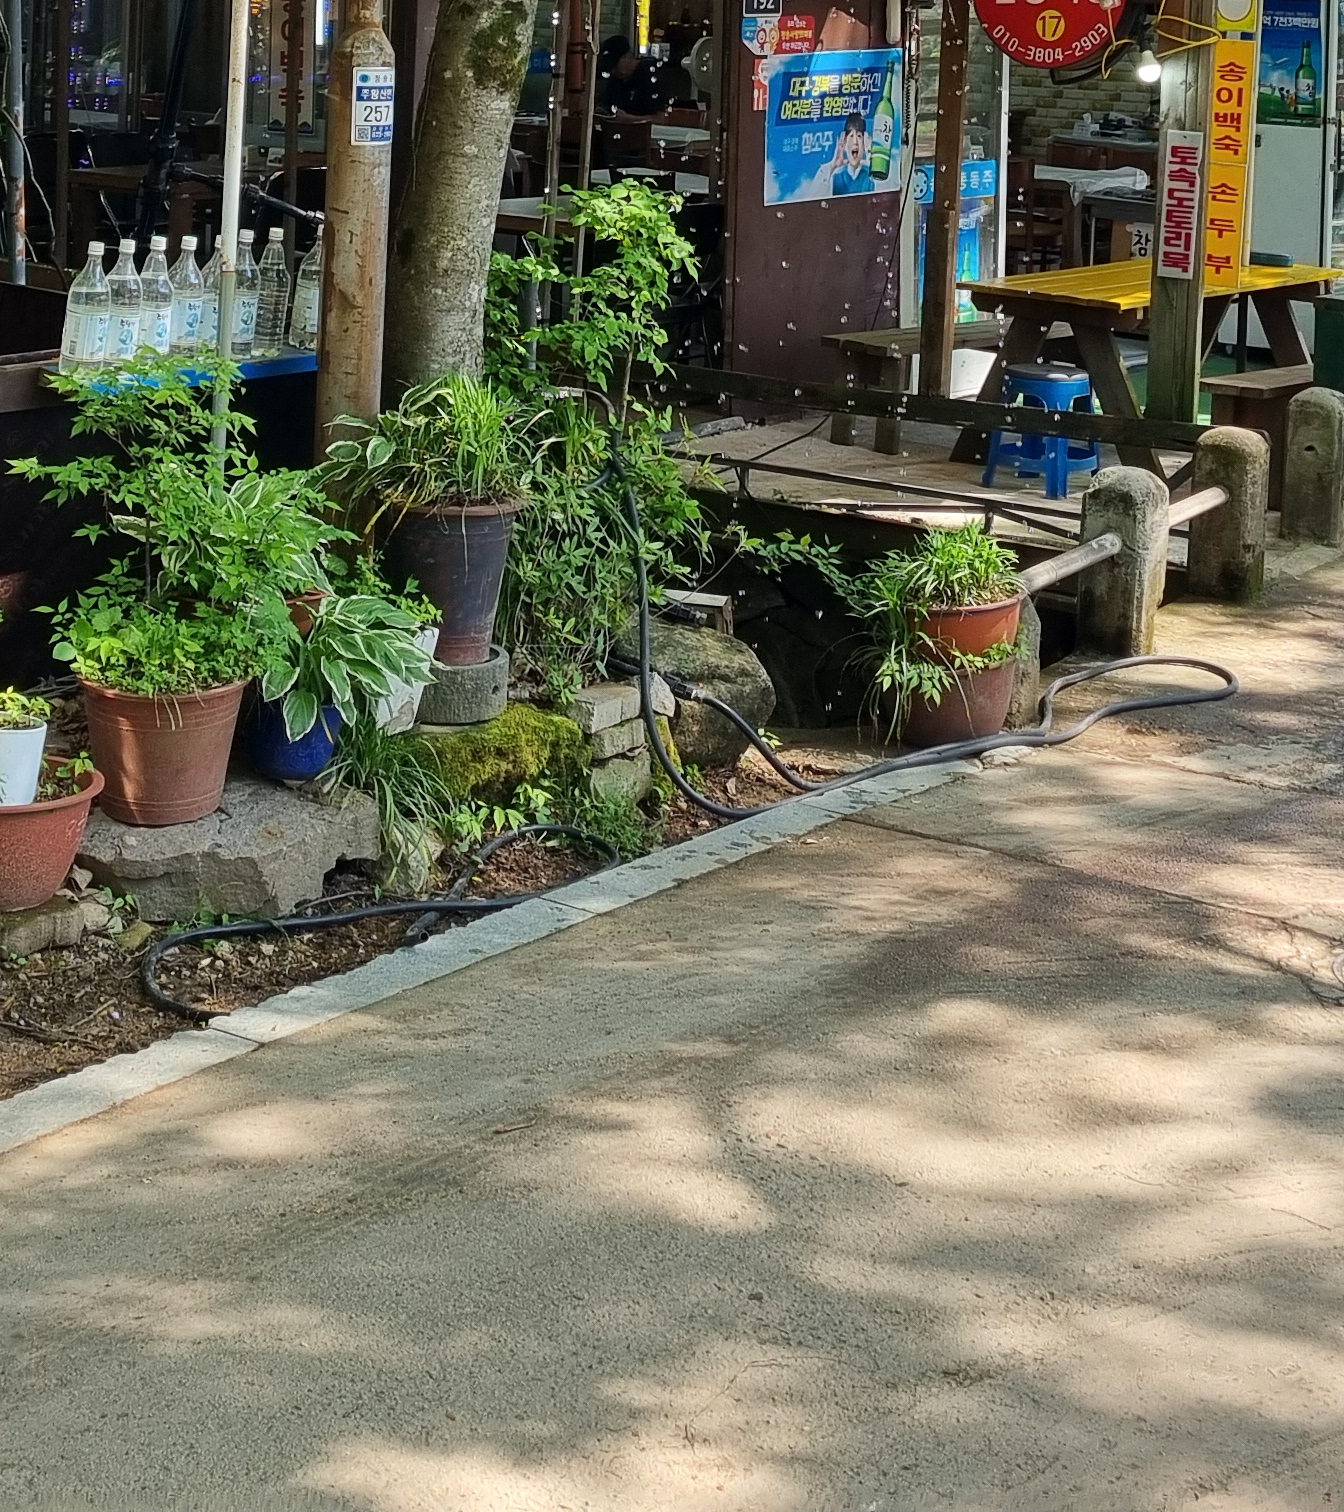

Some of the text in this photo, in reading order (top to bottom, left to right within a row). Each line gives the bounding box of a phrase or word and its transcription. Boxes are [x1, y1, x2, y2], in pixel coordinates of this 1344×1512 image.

[1038, 15, 1063, 38] 17
[993, 23, 1109, 63] 010-3804-2903
[841, 72, 882, 94] 방문하신
[363, 105, 390, 123] 257
[780, 94, 872, 121] 여러분을 환영합니다
[1212, 60, 1247, 156] 송이백숙
[800, 130, 834, 155] 참소주
[882, 120, 893, 143] 참
[1161, 145, 1199, 274] 토속도토리묵
[1204, 182, 1239, 275] 손두부
[1133, 229, 1152, 257] 참
